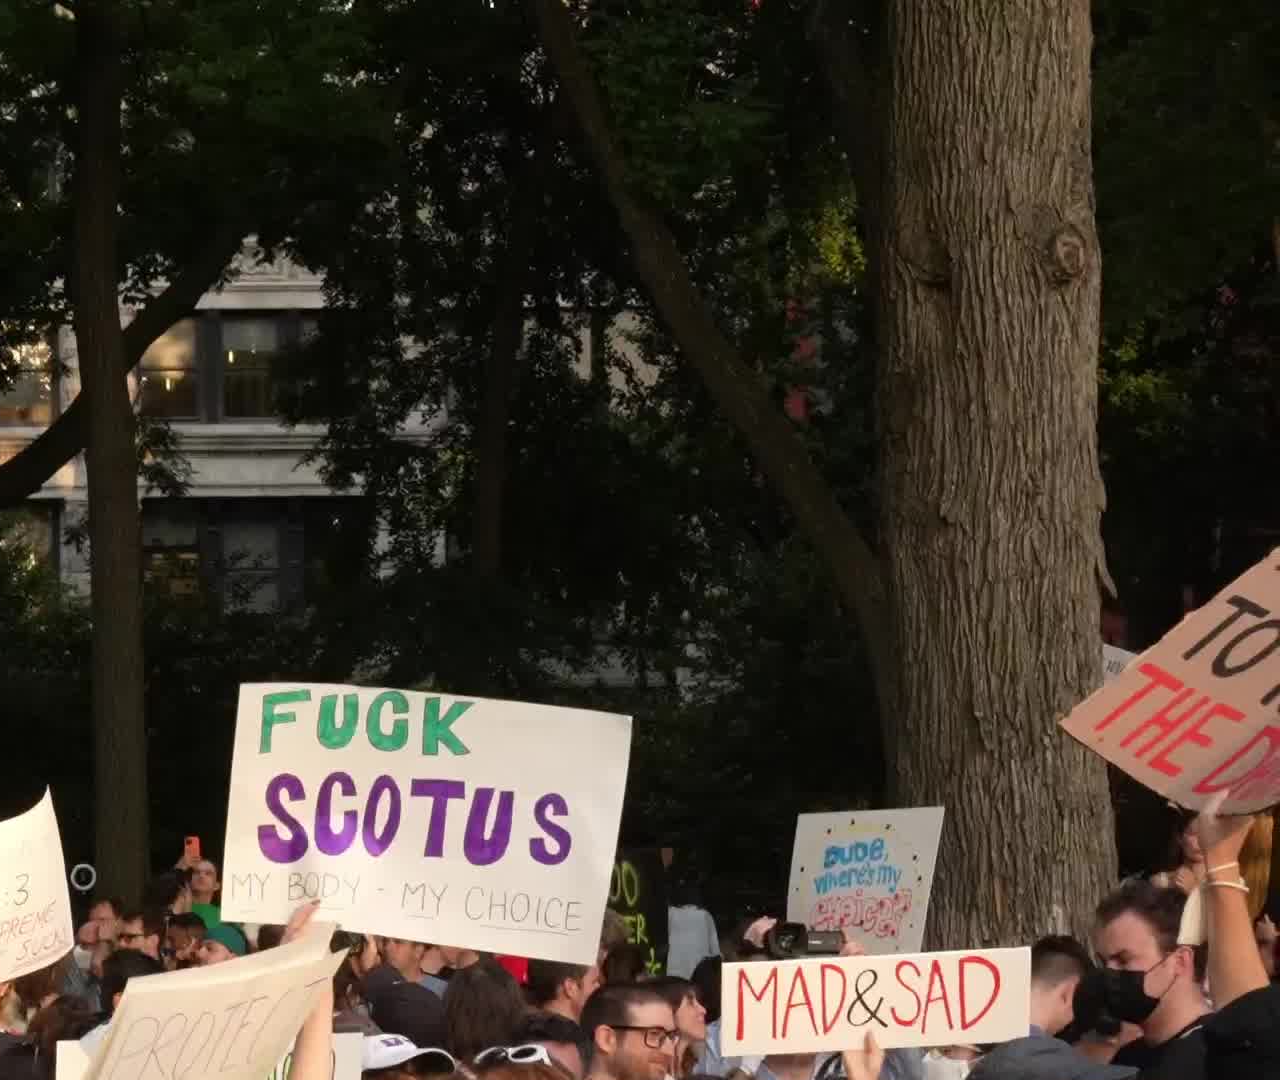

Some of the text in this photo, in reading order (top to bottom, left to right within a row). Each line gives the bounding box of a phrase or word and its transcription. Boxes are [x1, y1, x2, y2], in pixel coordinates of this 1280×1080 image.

[258, 688, 478, 756] FUCK
[1093, 663, 1247, 777] THE
[257, 771, 572, 866] SCOTUS
[231, 872, 271, 901] MY
[287, 872, 361, 902] BODY
[401, 882, 449, 913] MY
[464, 886, 585, 932] CHOICE
